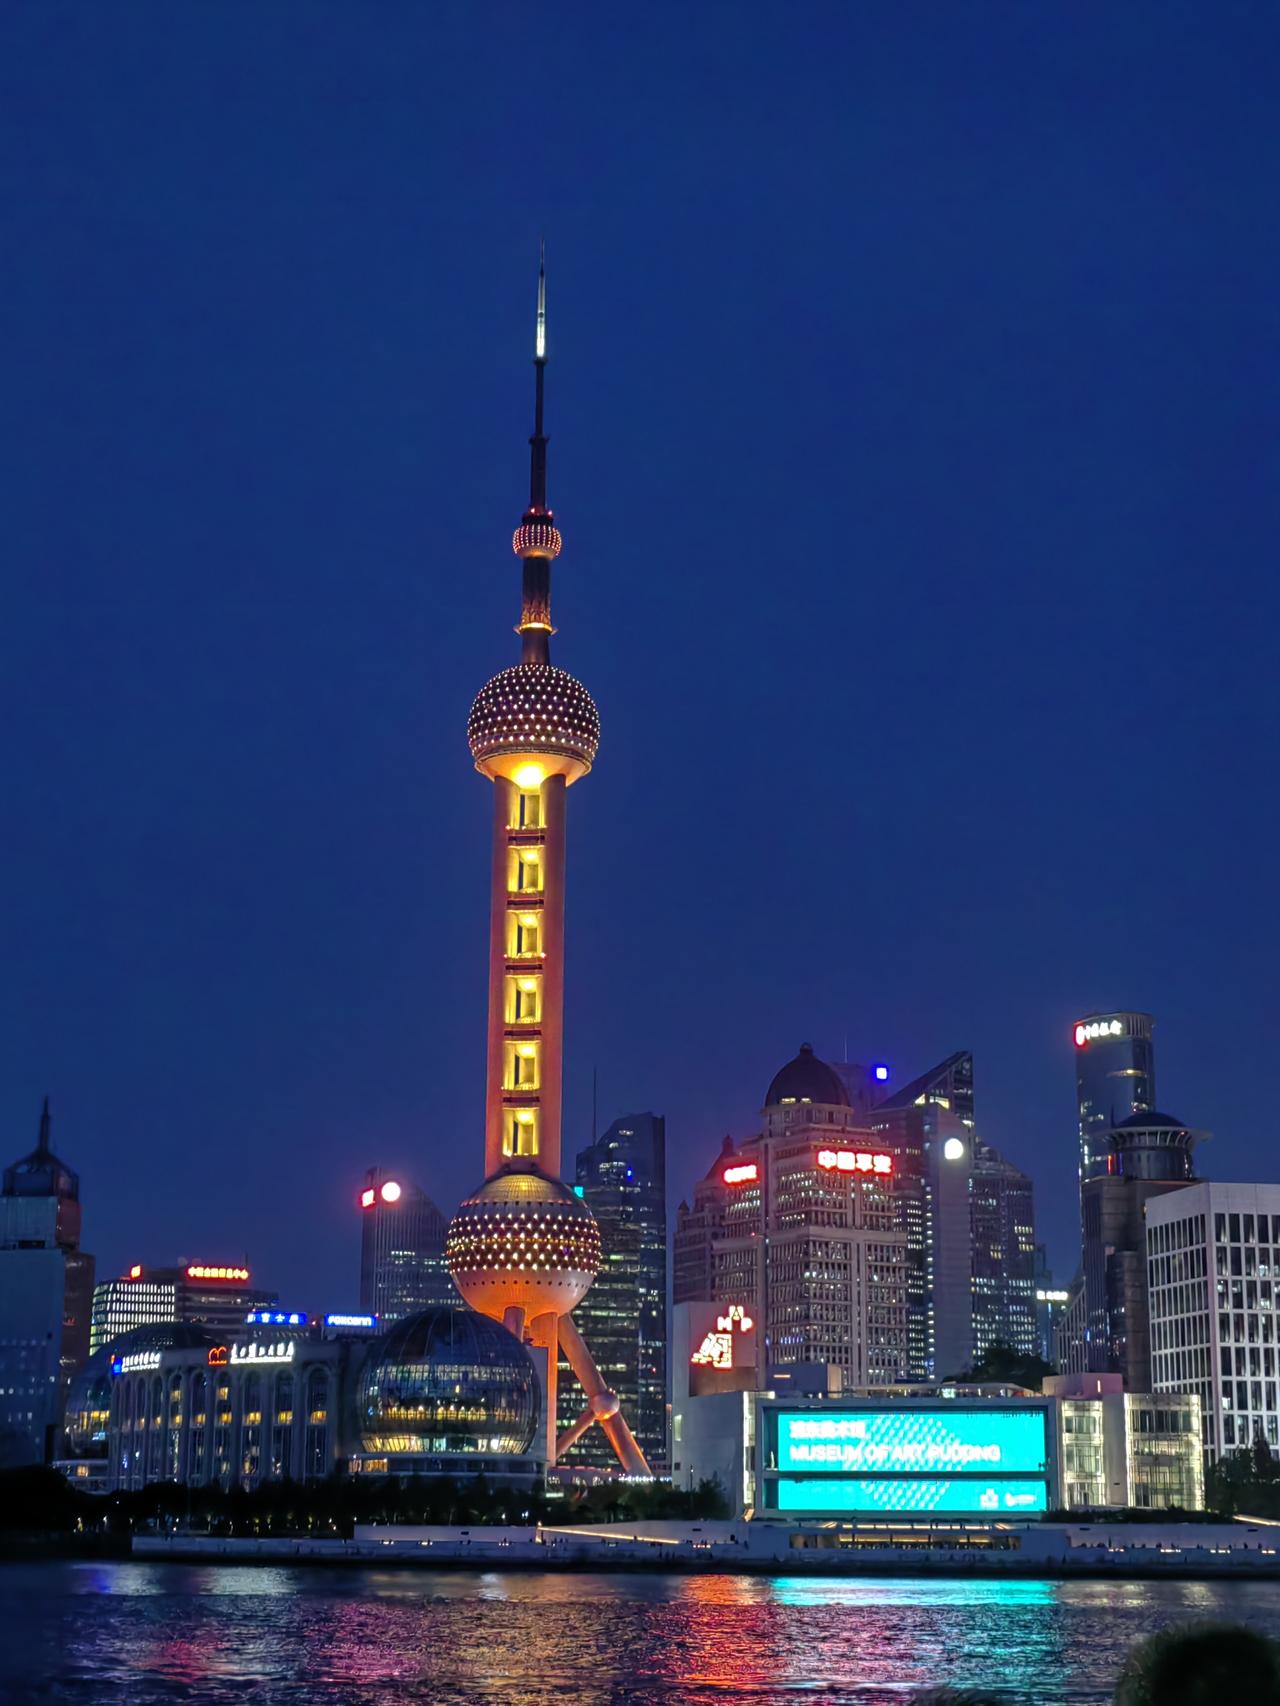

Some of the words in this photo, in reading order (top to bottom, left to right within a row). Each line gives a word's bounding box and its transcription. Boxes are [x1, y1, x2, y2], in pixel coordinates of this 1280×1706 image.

[790, 1444, 862, 1461] MUSEUM
[864, 1444, 890, 1462] OF
[892, 1444, 925, 1461] ART
[927, 1444, 1000, 1461] PUDONG
